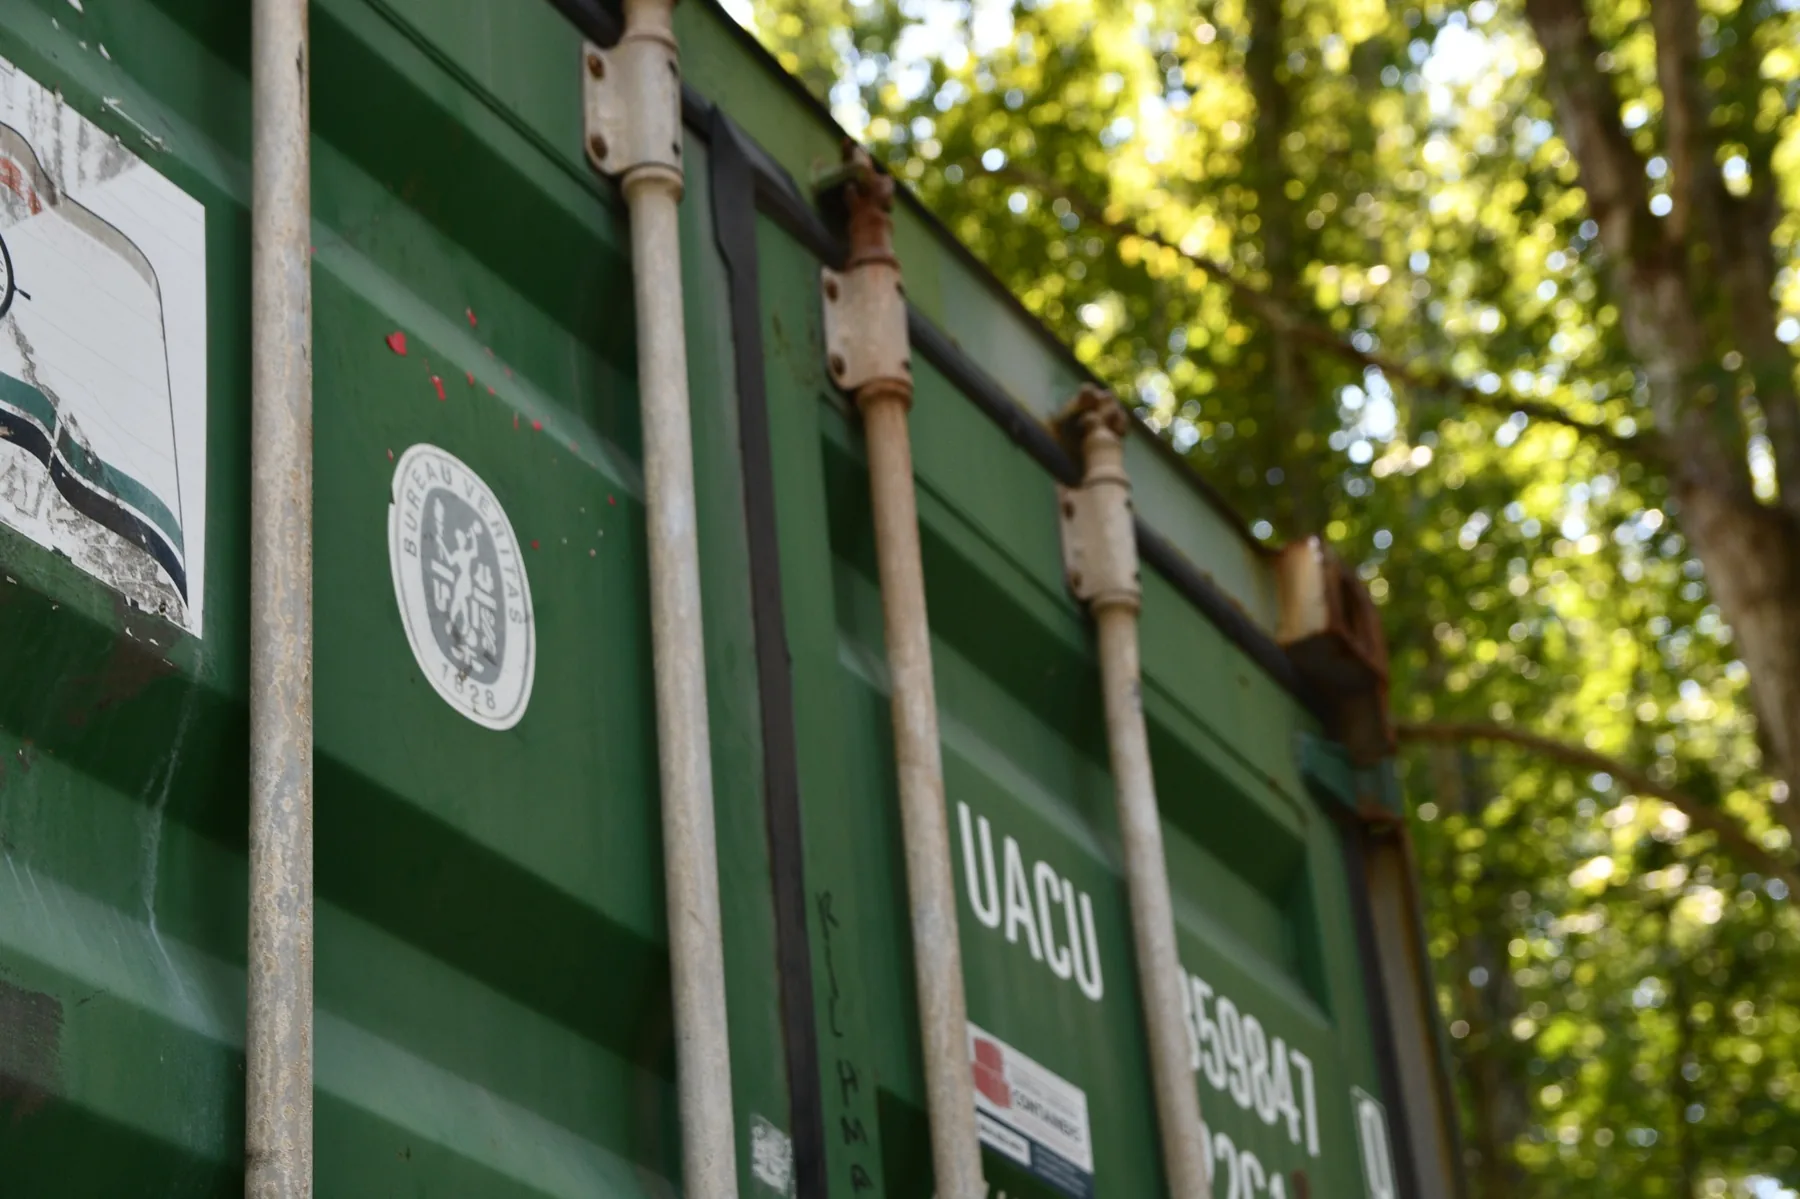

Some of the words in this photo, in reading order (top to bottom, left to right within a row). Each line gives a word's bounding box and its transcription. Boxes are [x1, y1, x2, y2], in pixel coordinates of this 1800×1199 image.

[404, 461, 453, 558] BUREAU
[462, 479, 524, 626] VERITAS
[440, 663, 496, 711] 1828
[957, 800, 1103, 1001] UACU
